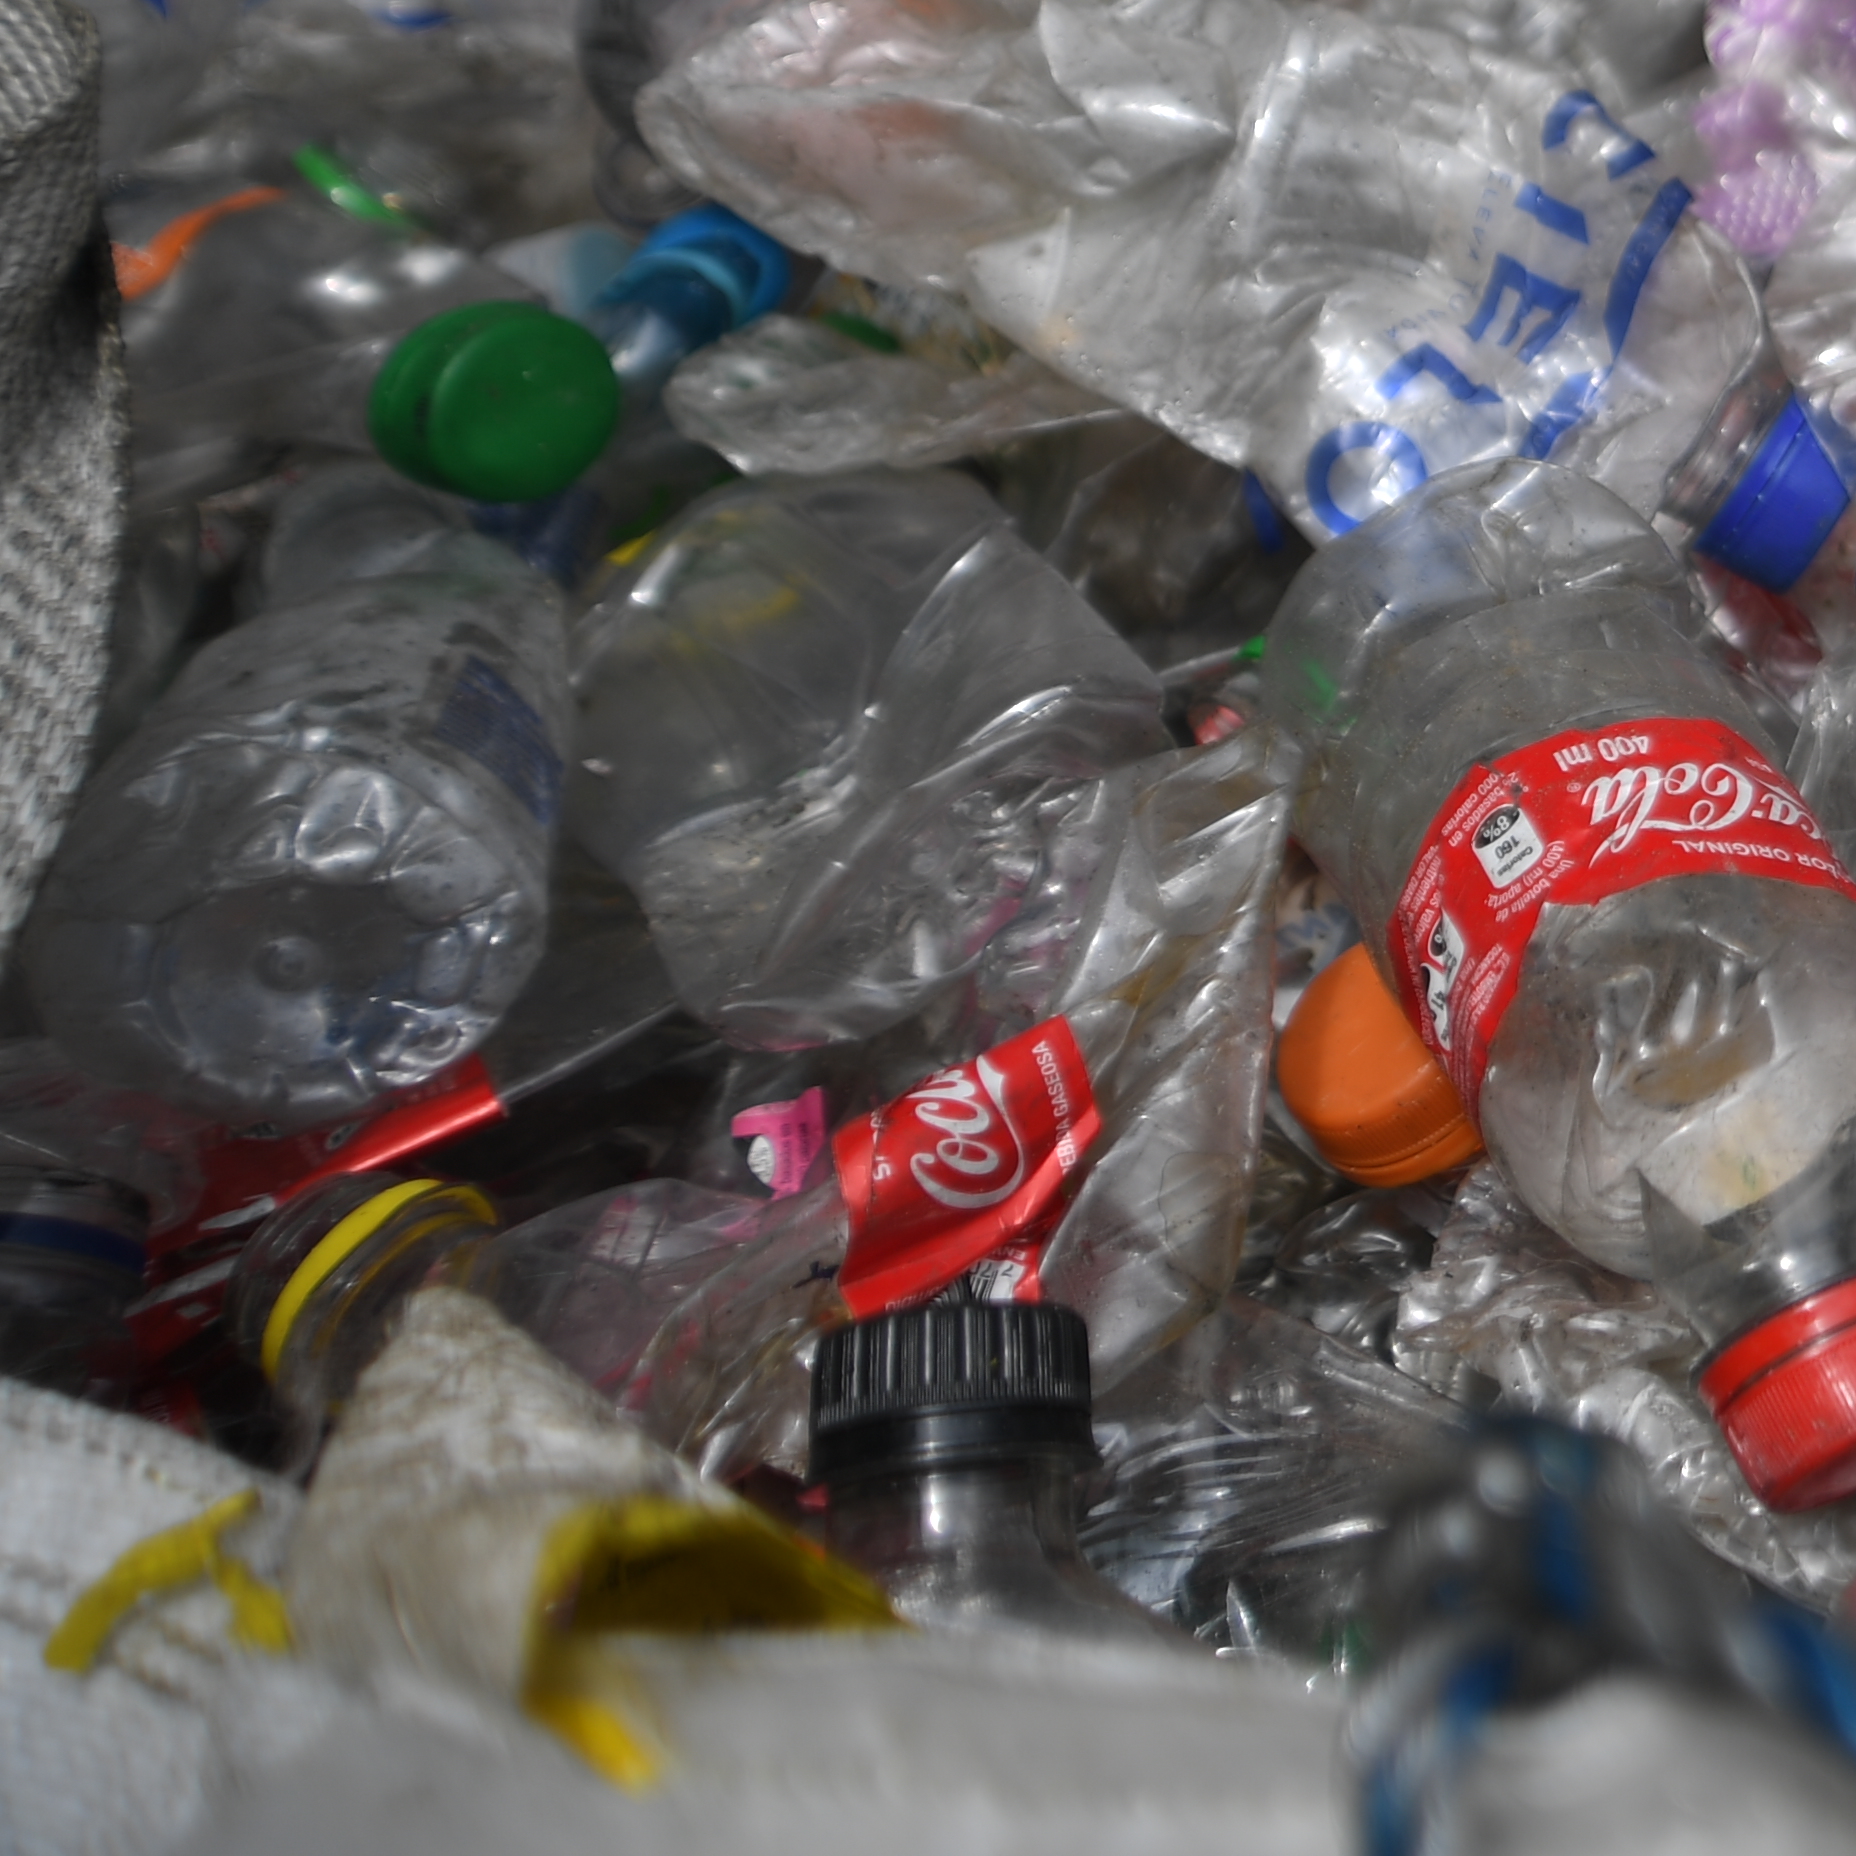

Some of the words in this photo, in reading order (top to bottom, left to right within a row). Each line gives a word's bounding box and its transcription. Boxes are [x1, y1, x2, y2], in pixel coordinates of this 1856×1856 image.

[1552, 742, 1587, 770] ml
[1595, 733, 1648, 760] 400
[1438, 792, 1477, 836] calorías
[1460, 785, 1505, 833] basados
[1580, 762, 1819, 867] ca-Cola
[1447, 830, 1464, 848] en
[1480, 813, 1511, 842] 8%
[1491, 834, 1520, 859] 160
[1540, 841, 1563, 867] (400
[1672, 839, 1787, 861] ORIGINAL
[1547, 858, 1573, 879] Una
[1507, 877, 1549, 914] botella
[1494, 909, 1510, 922] de
[1032, 1041, 1068, 1119] GASEOSA
